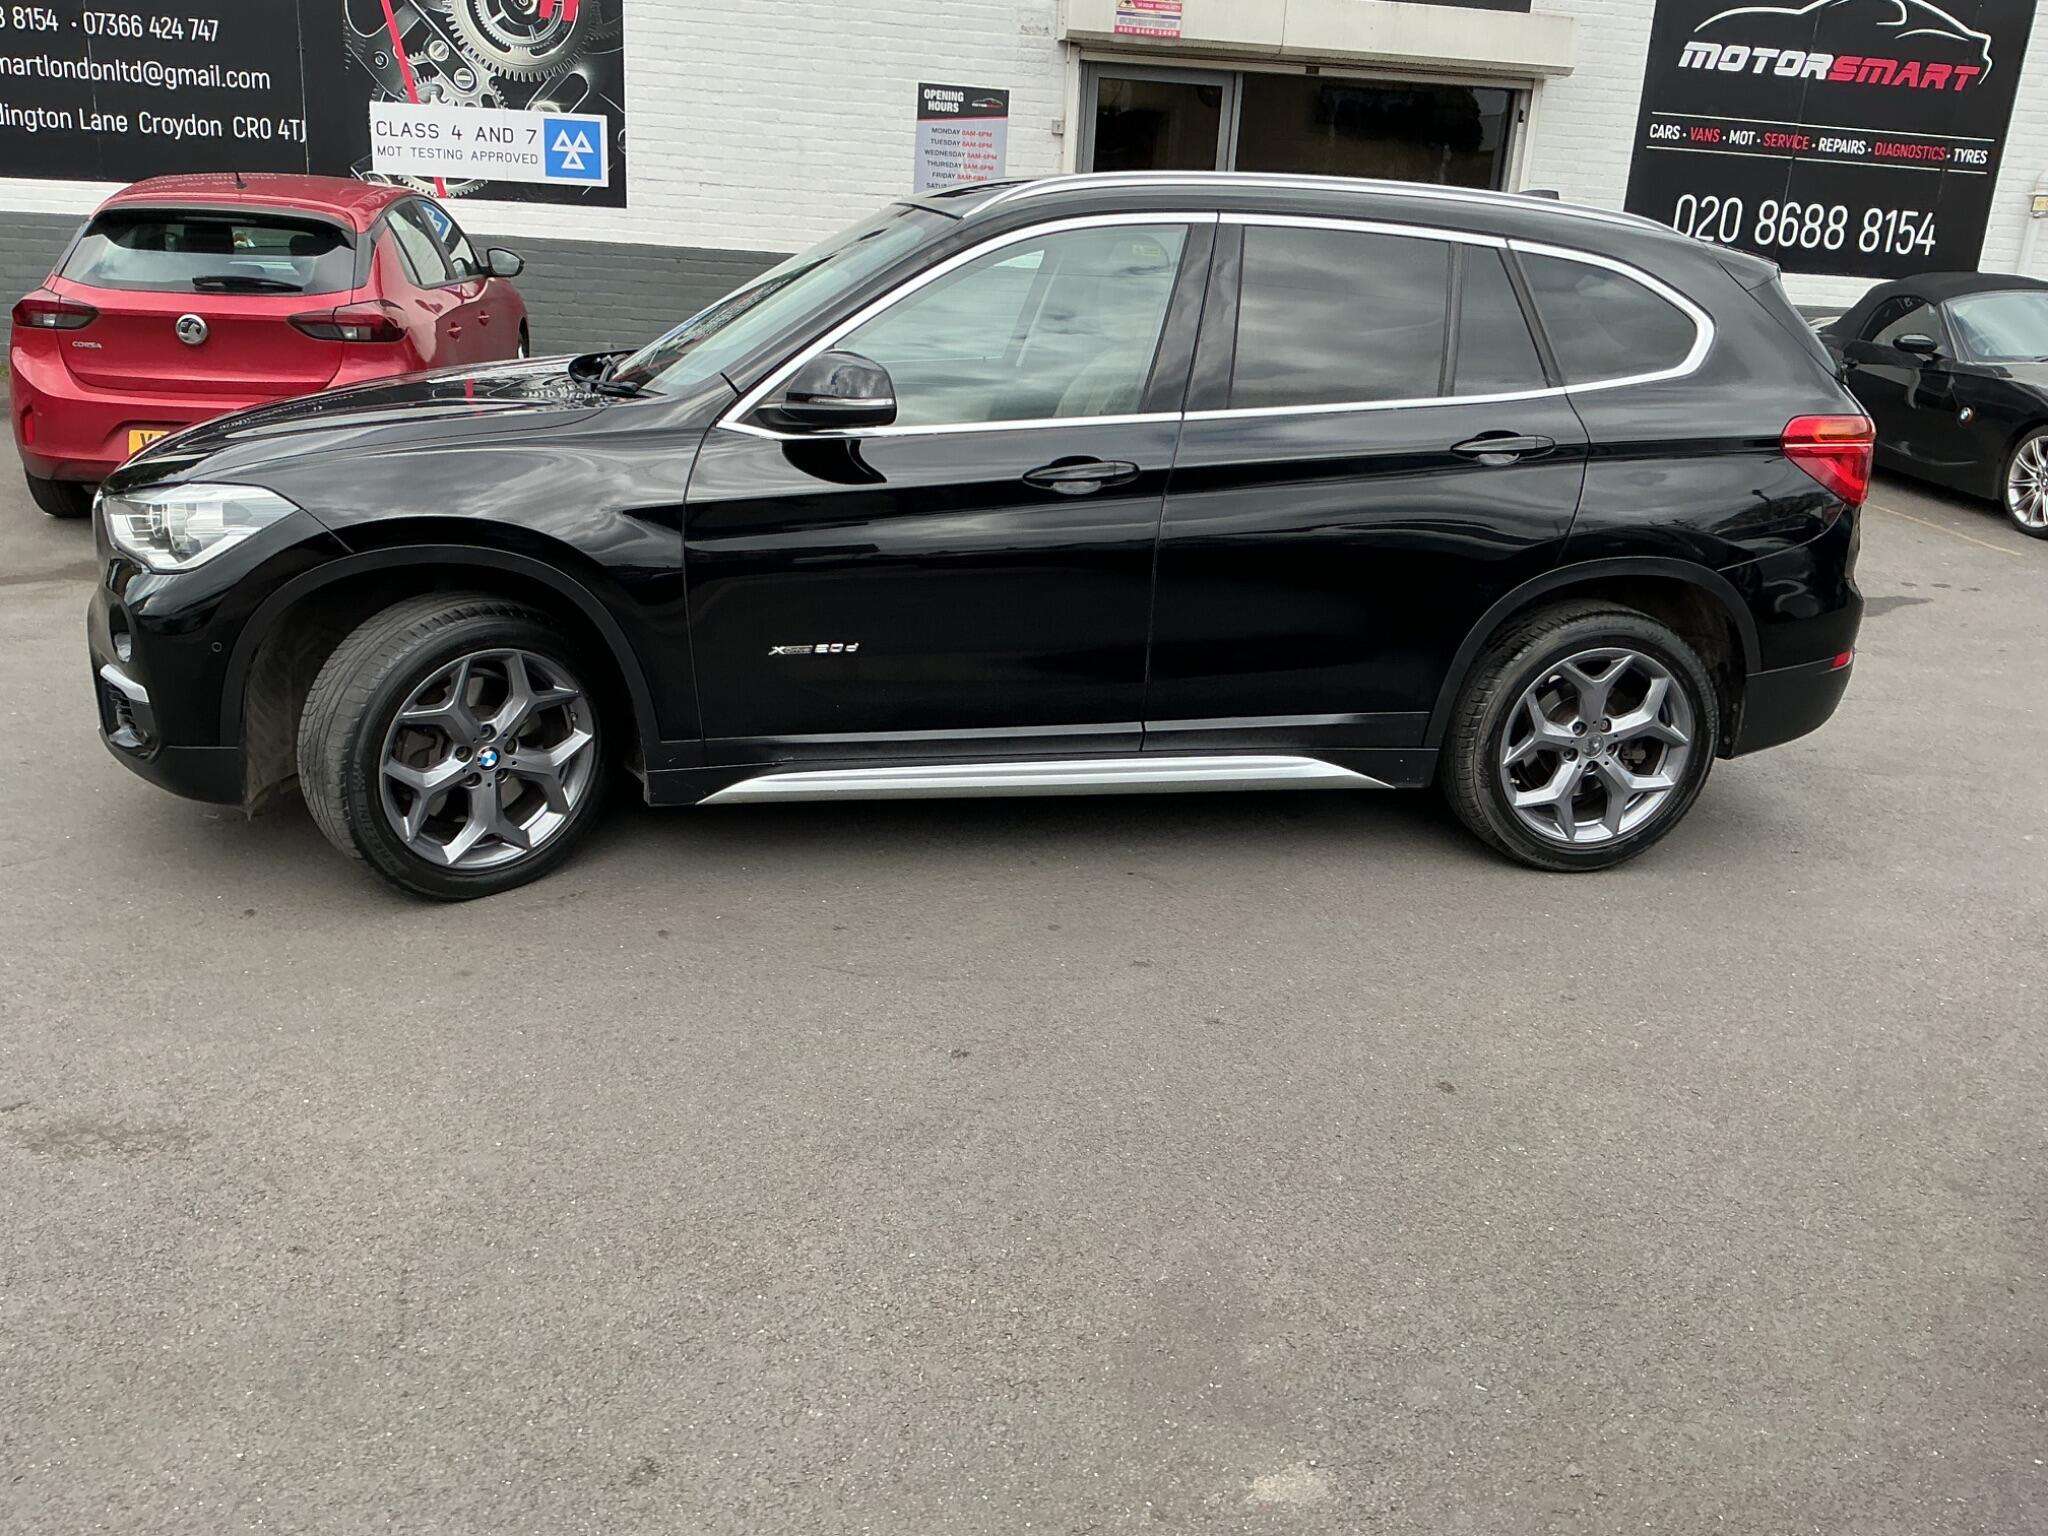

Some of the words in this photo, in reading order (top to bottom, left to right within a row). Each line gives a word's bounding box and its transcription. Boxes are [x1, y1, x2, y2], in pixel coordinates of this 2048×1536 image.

[12, 6, 59, 32] 8154
[83, 11, 143, 38] 07366
[149, 15, 184, 40] 424
[188, 18, 219, 42] 747
[1678, 41, 1980, 91] MOTORSMART
[924, 89, 964, 101] OPENING
[928, 101, 959, 113] HOURS
[79, 108, 129, 133] Lane
[138, 111, 222, 140] Croydon
[277, 118, 307, 143] 4TJ
[375, 120, 440, 139] CLASS
[451, 124, 463, 140] 4
[475, 126, 514, 144] AND
[525, 129, 538, 145] 7
[931, 127, 961, 135] MONDAY
[924, 149, 966, 159] WEDNESDAY
[1649, 123, 1681, 140] CARS
[1690, 126, 1721, 143] VANS
[1728, 129, 1756, 145] MOT
[1763, 132, 1811, 150] SERVICE
[1818, 137, 1867, 155] REPAIRS
[1874, 141, 1947, 161] DIAGNOSTICS
[1954, 148, 1988, 165] TYRES
[377, 145, 402, 158] MOT
[411, 147, 463, 161] TESTING
[471, 150, 538, 165] APPROVED
[927, 159, 962, 168] THURSDAY
[1673, 193, 1743, 243] 020
[1754, 199, 1849, 251] 8688
[1858, 207, 1936, 256] 8154
[72, 341, 102, 349] CORSA
